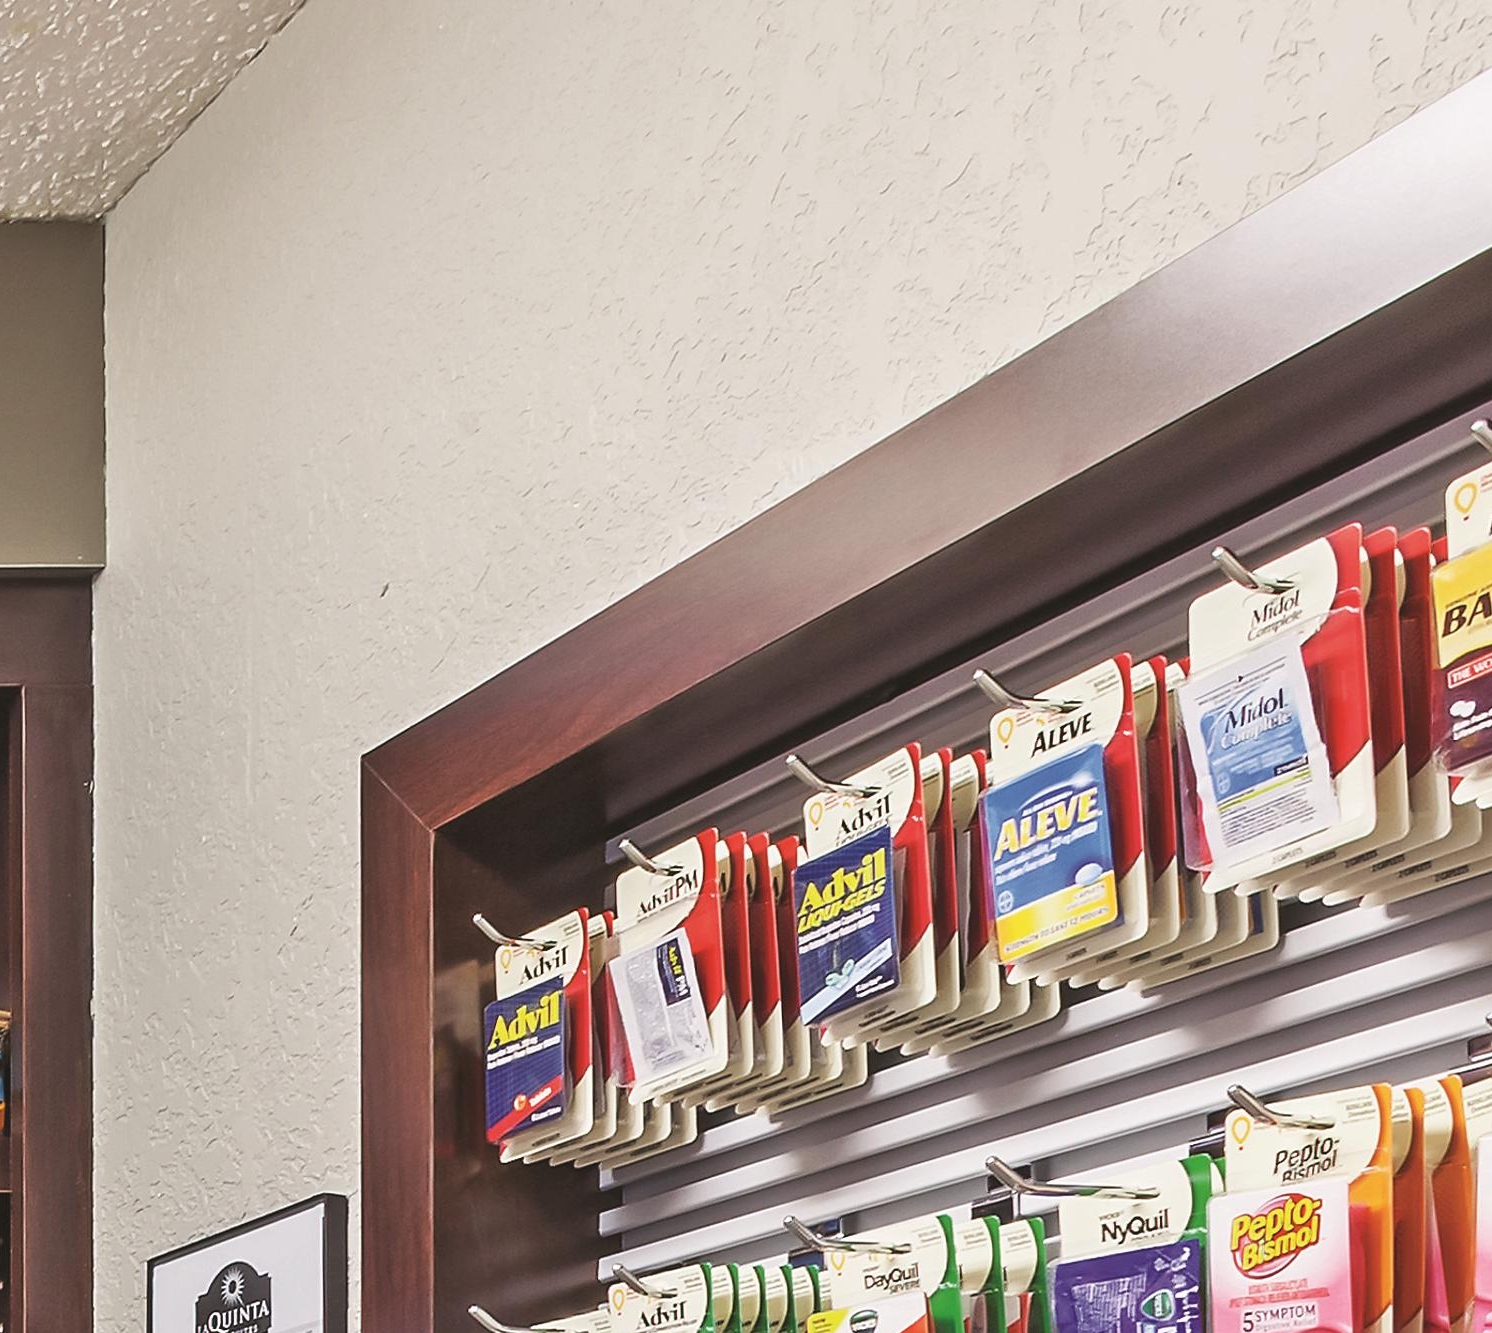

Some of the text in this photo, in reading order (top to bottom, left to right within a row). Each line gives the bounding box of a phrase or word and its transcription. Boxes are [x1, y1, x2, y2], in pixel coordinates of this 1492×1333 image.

[1250, 590, 1301, 628] Midol
[1223, 688, 1287, 734] Midol
[1030, 712, 1093, 759] ALEVE
[838, 791, 893, 835] Advil
[994, 788, 1102, 862] ALEVE
[799, 847, 887, 916] Advil
[518, 945, 569, 985] Advil
[488, 992, 561, 1049] Advil
[1274, 1138, 1340, 1177] Pepto-
[1101, 1209, 1169, 1245] NyQuil
[1231, 1193, 1322, 1251] Pepto-
[1242, 1227, 1318, 1273] Bismol
[864, 1265, 920, 1291] DayQuil
[208, 1300, 269, 1333] QUINTA
[636, 1304, 686, 1330] Advil
[1243, 1304, 1316, 1332] 5 SYMPTOM
